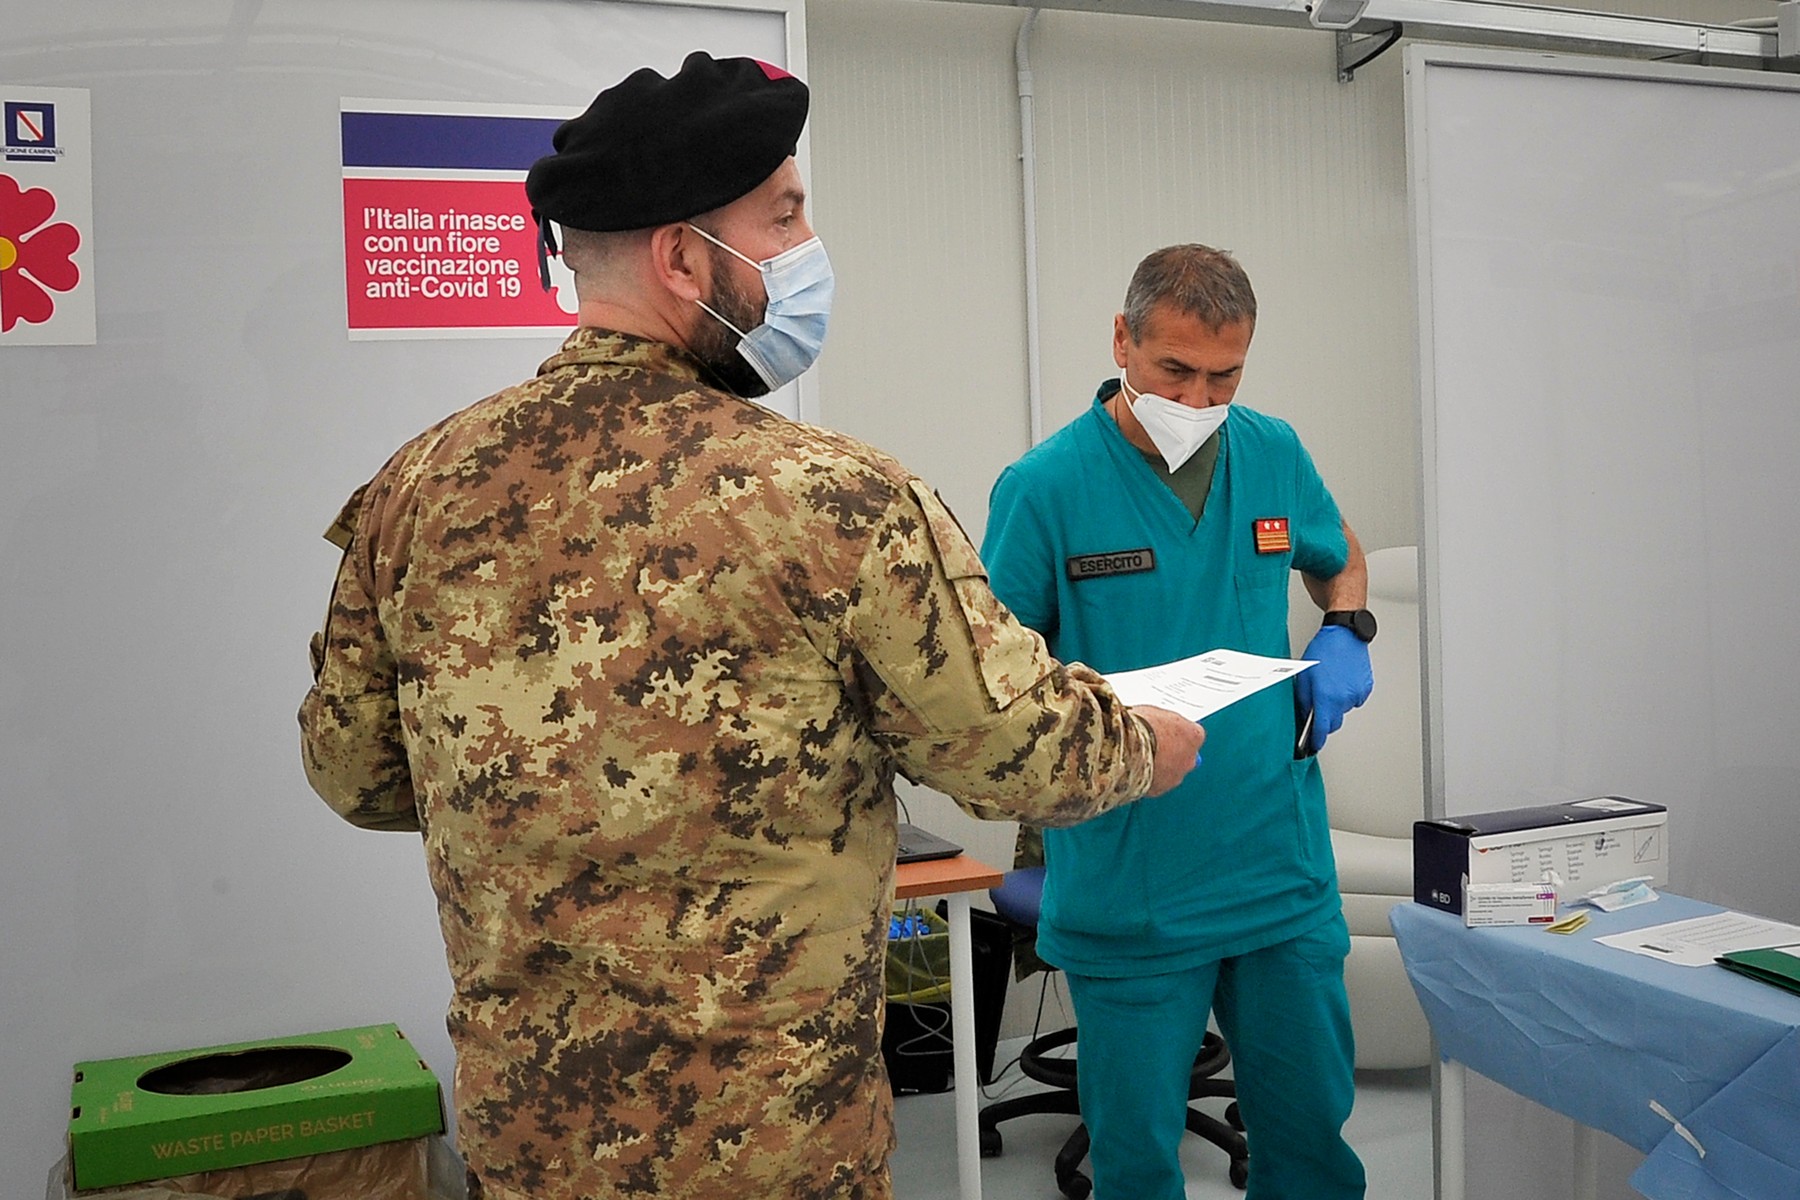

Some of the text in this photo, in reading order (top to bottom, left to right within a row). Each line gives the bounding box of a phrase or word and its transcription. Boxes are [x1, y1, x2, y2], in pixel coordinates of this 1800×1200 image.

[364, 208, 525, 231] l'Italia rinasce
[364, 231, 500, 253] con un fiore
[365, 254, 520, 275] vaccinazione
[366, 276, 521, 298] anti-Covid 19
[1080, 555, 1143, 573] ESERCITO
[1440, 892, 1451, 905] BD
[152, 1110, 376, 1160] WASTE PAPER BASKET
